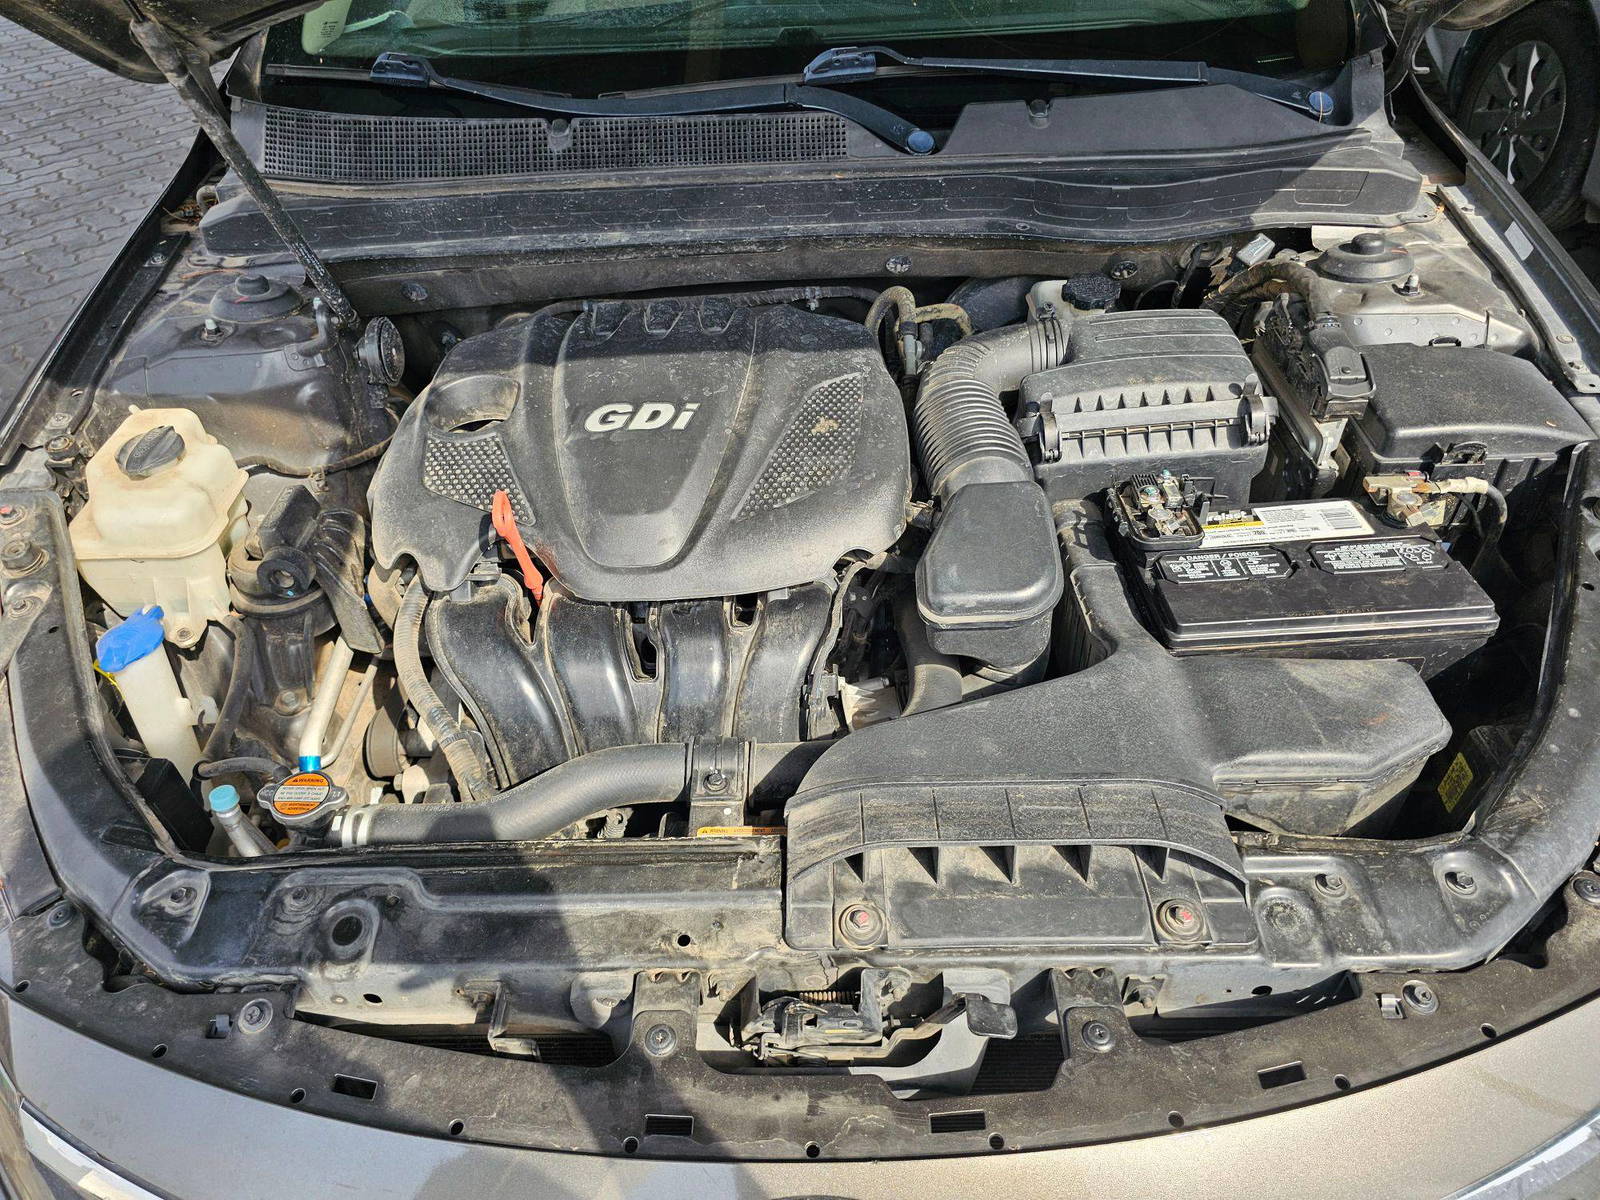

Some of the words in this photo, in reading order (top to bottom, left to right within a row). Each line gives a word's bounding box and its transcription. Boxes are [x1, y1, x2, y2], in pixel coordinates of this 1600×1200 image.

[584, 402, 701, 432] GDi
[1186, 553, 1220, 561] DANGER
[1228, 551, 1260, 559] POISON
